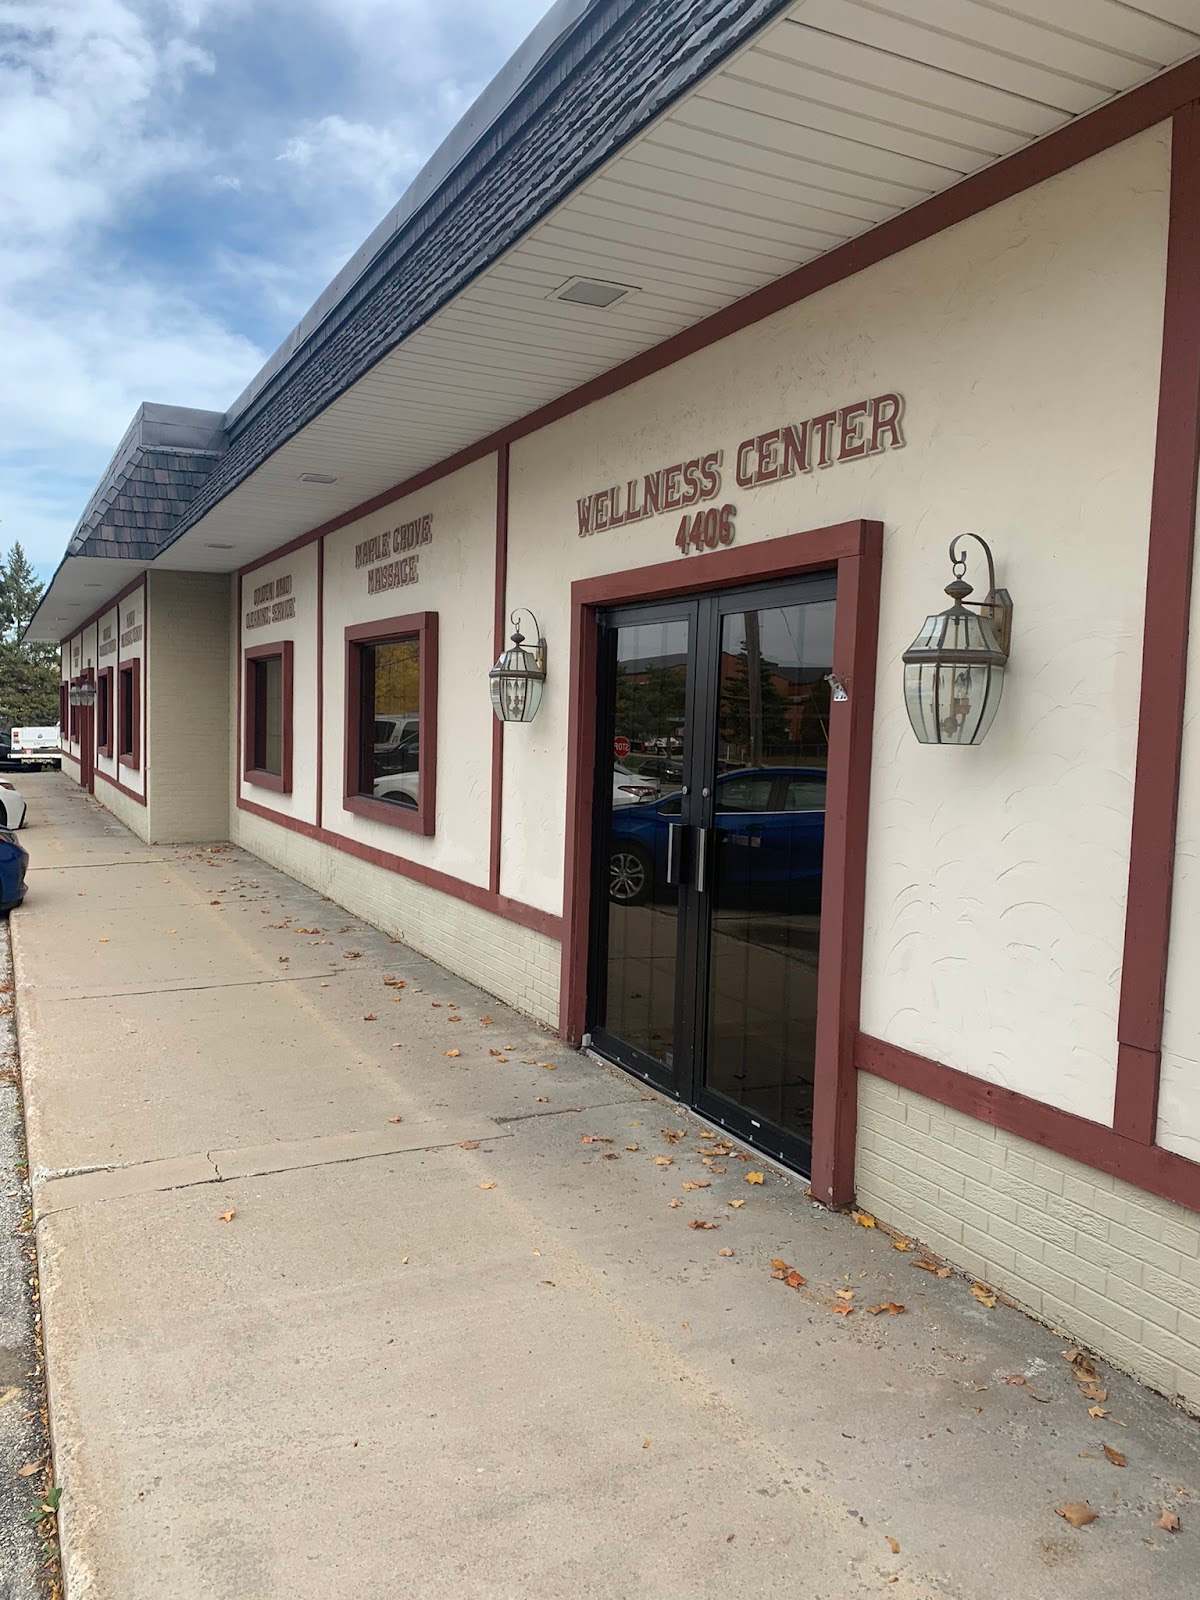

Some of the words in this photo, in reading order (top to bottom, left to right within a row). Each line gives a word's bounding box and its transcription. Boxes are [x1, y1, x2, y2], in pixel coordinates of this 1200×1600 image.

[577, 450, 723, 537] WELLNESS
[736, 393, 906, 488] CENTER
[354, 531, 391, 569] MAPLE
[392, 513, 433, 554] GROVE
[674, 503, 737, 555] 4406
[368, 554, 419, 595] MASSAGE
